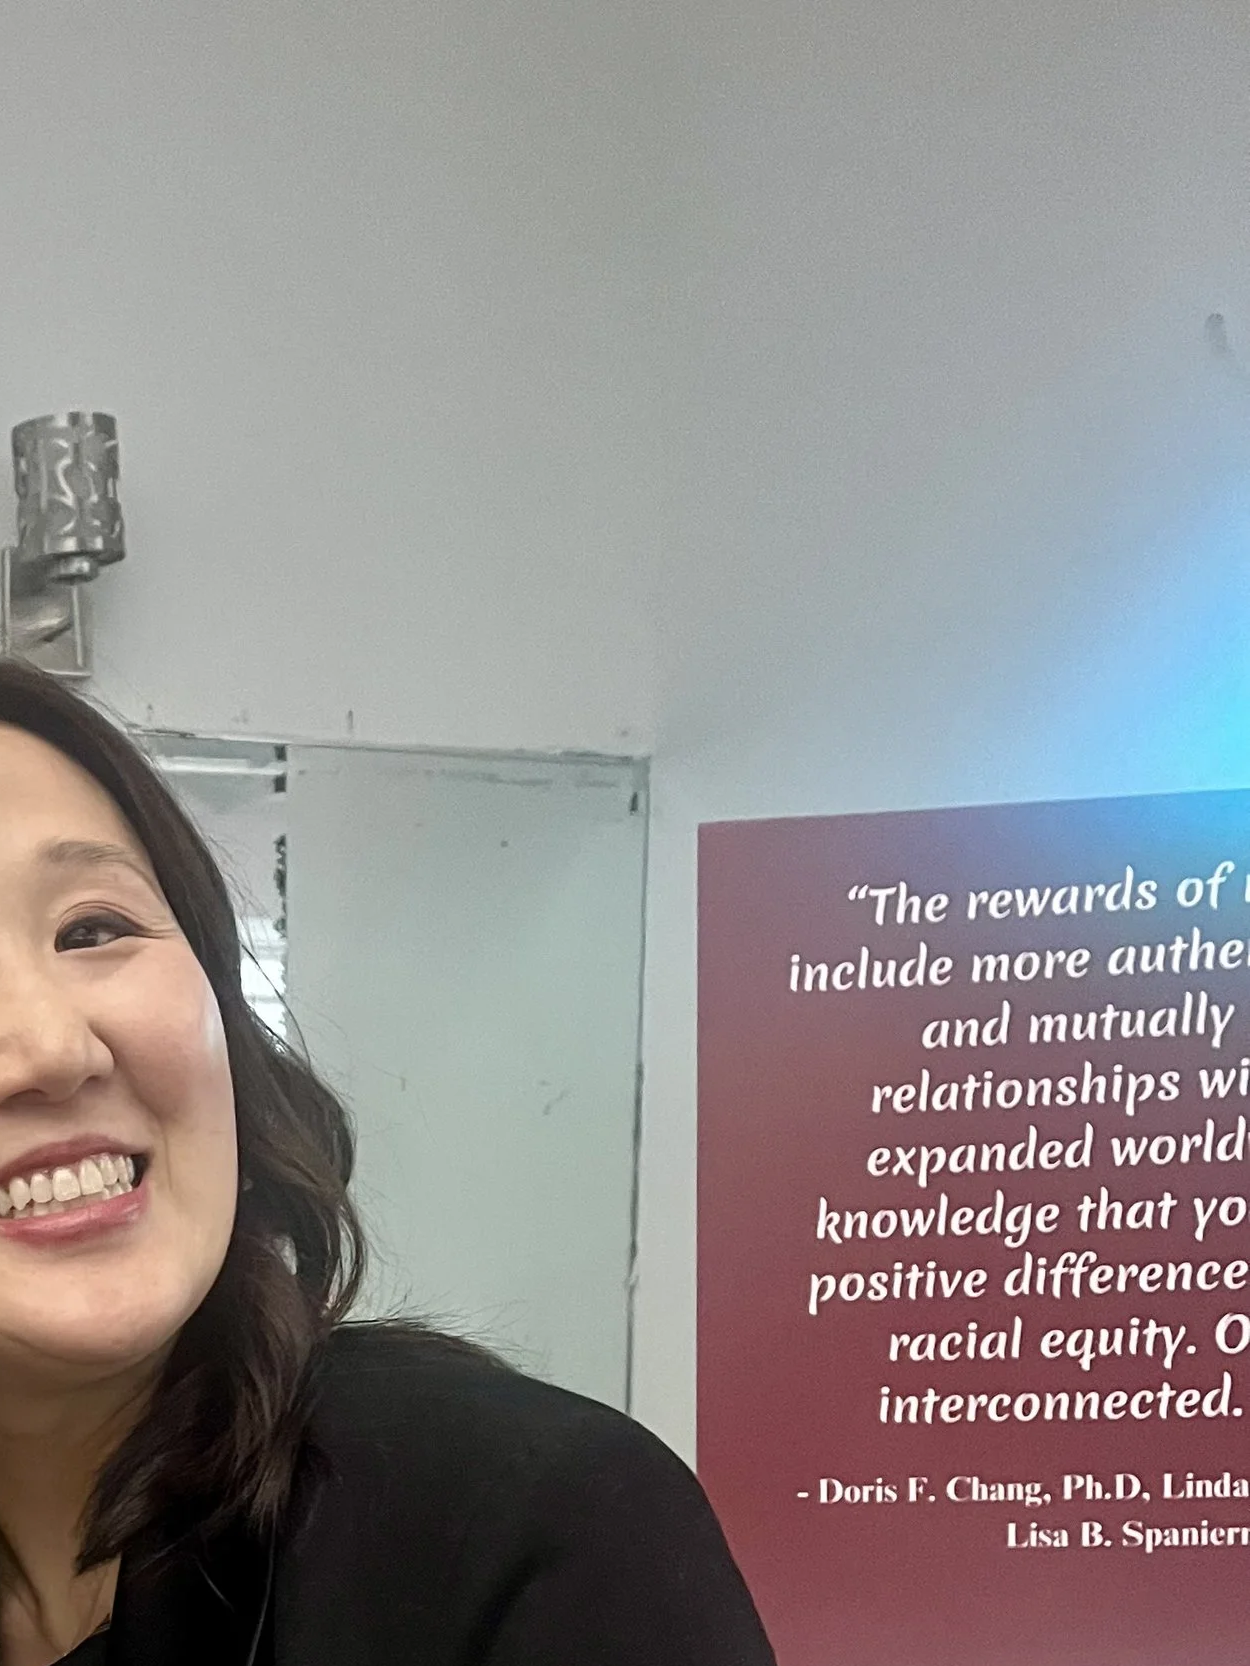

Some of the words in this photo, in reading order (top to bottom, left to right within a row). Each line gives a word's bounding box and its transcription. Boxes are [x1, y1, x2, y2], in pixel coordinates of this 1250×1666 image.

[848, 881, 948, 926] “The
[967, 865, 1158, 922] rewards
[1177, 861, 1235, 910] of
[789, 942, 953, 993] include
[971, 947, 1090, 983] more
[1107, 926, 1250, 975] authe
[922, 1001, 1010, 1049] and
[1029, 991, 1234, 1048] mutually
[871, 1062, 1181, 1116] relationships
[867, 1123, 1092, 1188] expanded
[1111, 1115, 1250, 1167] world
[816, 1189, 1059, 1247] knowledge
[1077, 1187, 1177, 1233] that
[808, 1260, 987, 1314] positive
[1003, 1251, 1249, 1300] difference
[888, 1316, 1021, 1362] racial
[1040, 1315, 1197, 1370] equity.
[878, 1371, 1243, 1425] interconnected.
[819, 1477, 898, 1504] Doris
[908, 1476, 936, 1502] F.
[946, 1475, 1051, 1508] Chang,
[1063, 1473, 1150, 1502] Ph.D,
[1163, 1472, 1250, 1499] Linda
[1007, 1522, 1069, 1548] Lisa
[1081, 1521, 1112, 1547] B.
